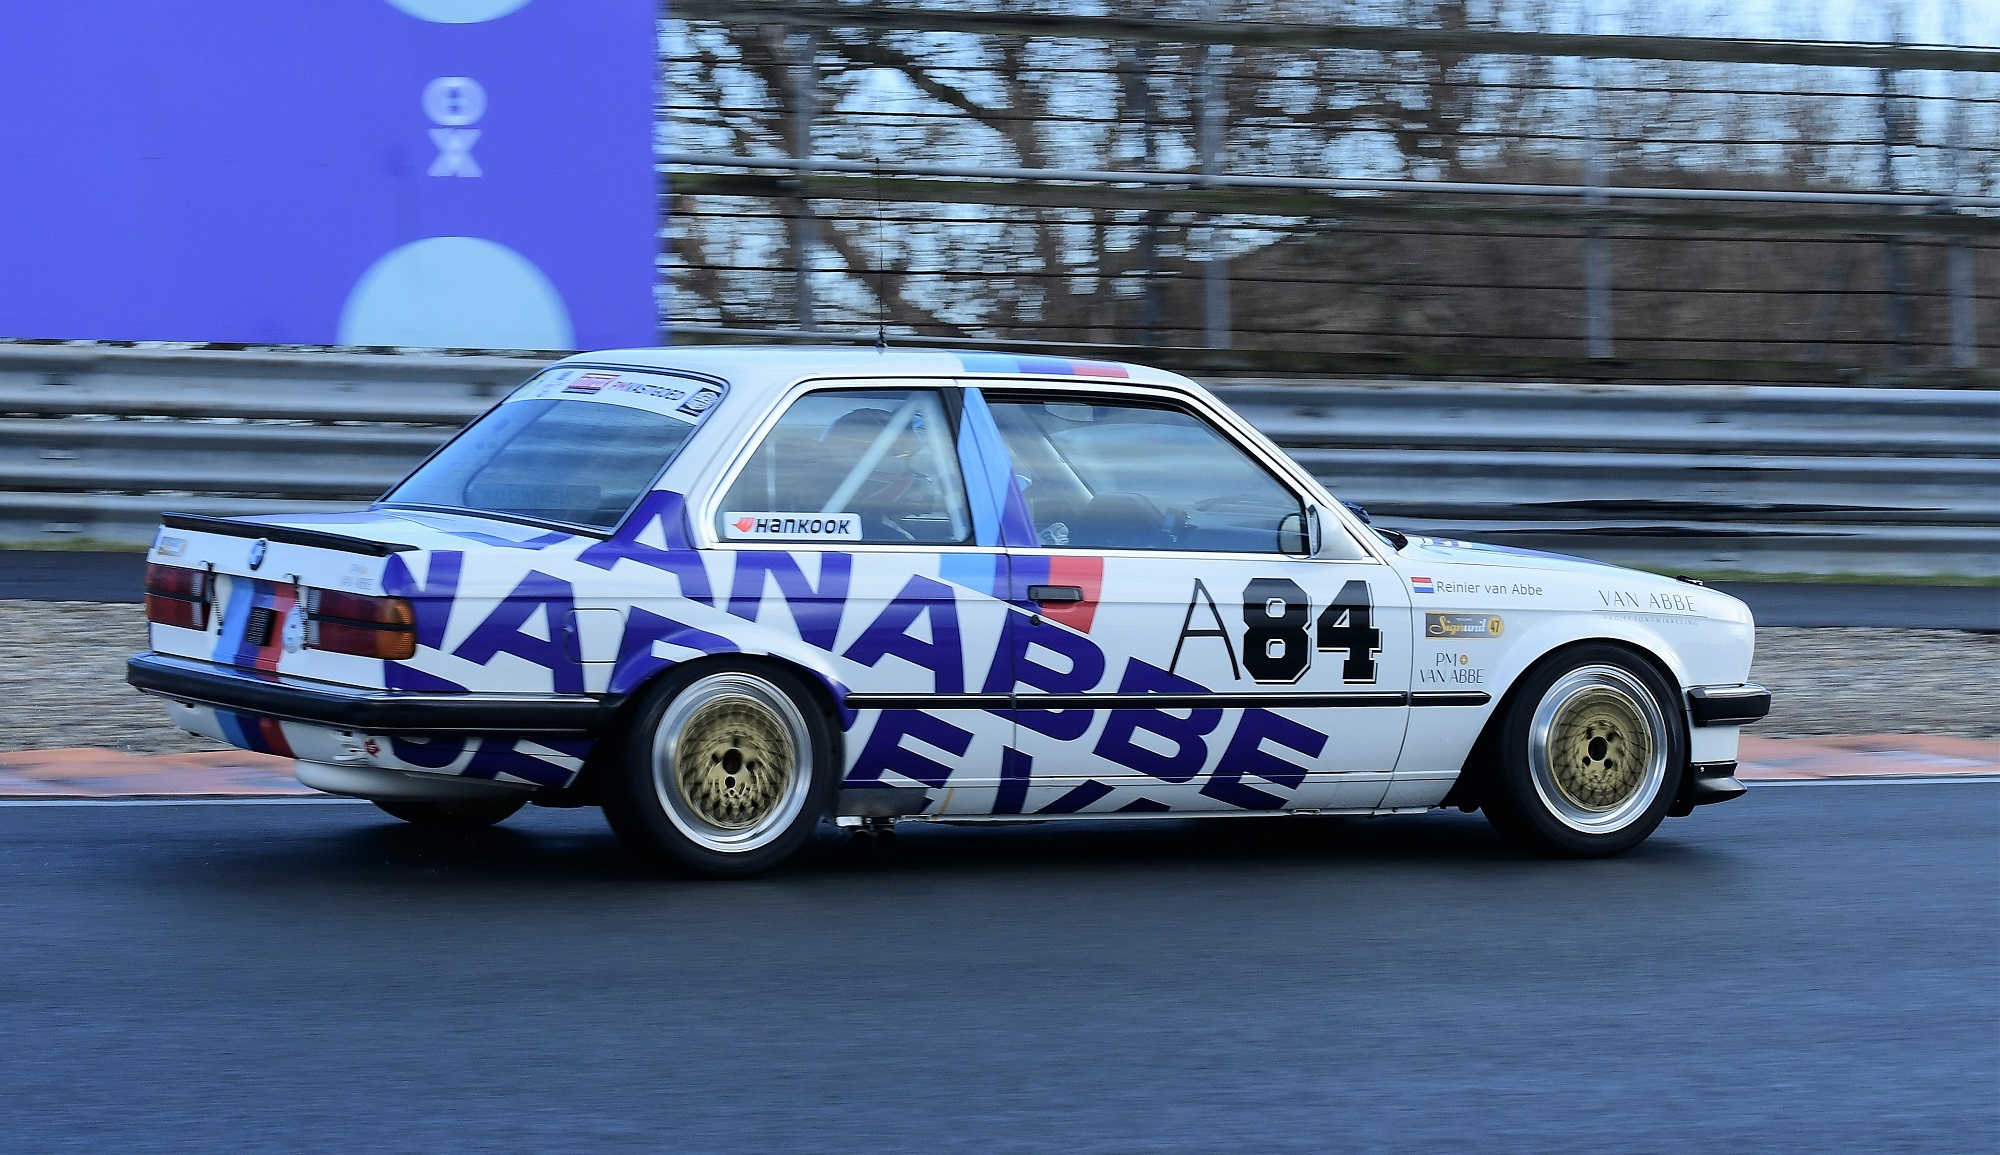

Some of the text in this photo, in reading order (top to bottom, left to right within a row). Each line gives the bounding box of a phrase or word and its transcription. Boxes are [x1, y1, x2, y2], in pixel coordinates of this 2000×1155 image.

[1436, 581, 1543, 596] Reinier van Abbe
[1598, 589, 1698, 613] VAN ABBE
[1449, 668, 1485, 684] ABBE
